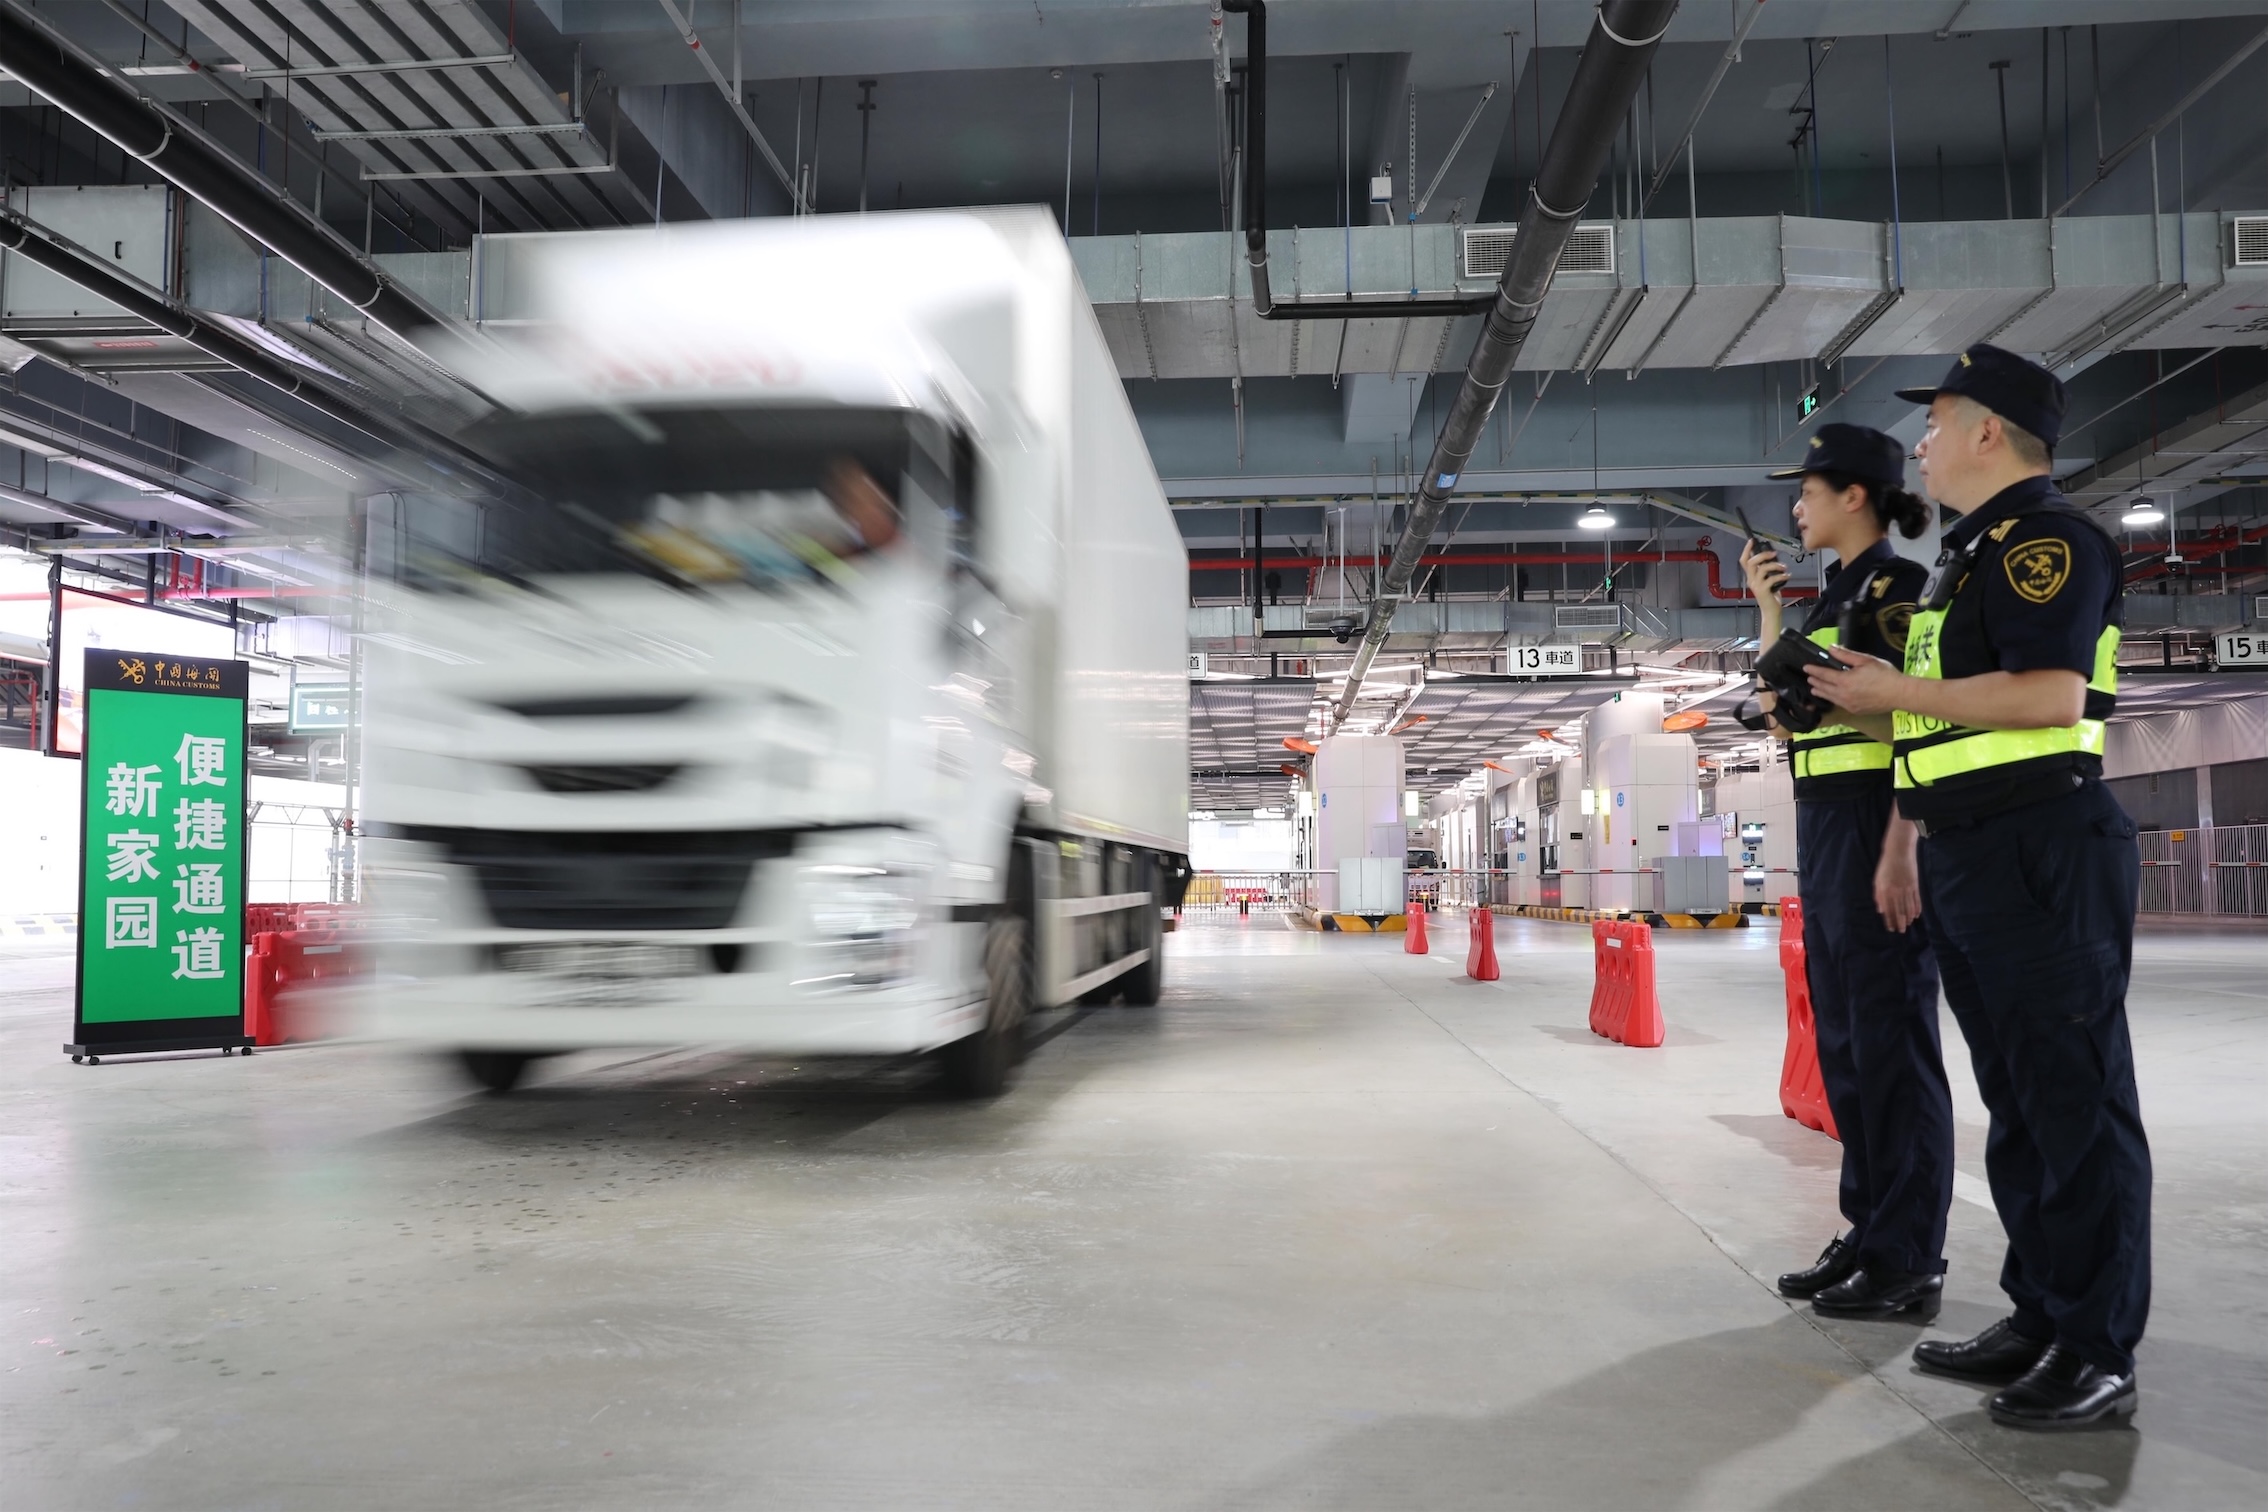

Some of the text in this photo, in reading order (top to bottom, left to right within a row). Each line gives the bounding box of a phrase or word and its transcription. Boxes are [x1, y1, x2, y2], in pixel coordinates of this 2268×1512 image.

[1518, 648, 1574, 668] 13 車道
[2227, 637, 2251, 658] 15
[154, 679, 221, 690] CHINA CUSTOMS
[105, 762, 163, 950] 新家园
[171, 732, 228, 980] 便捷通道
